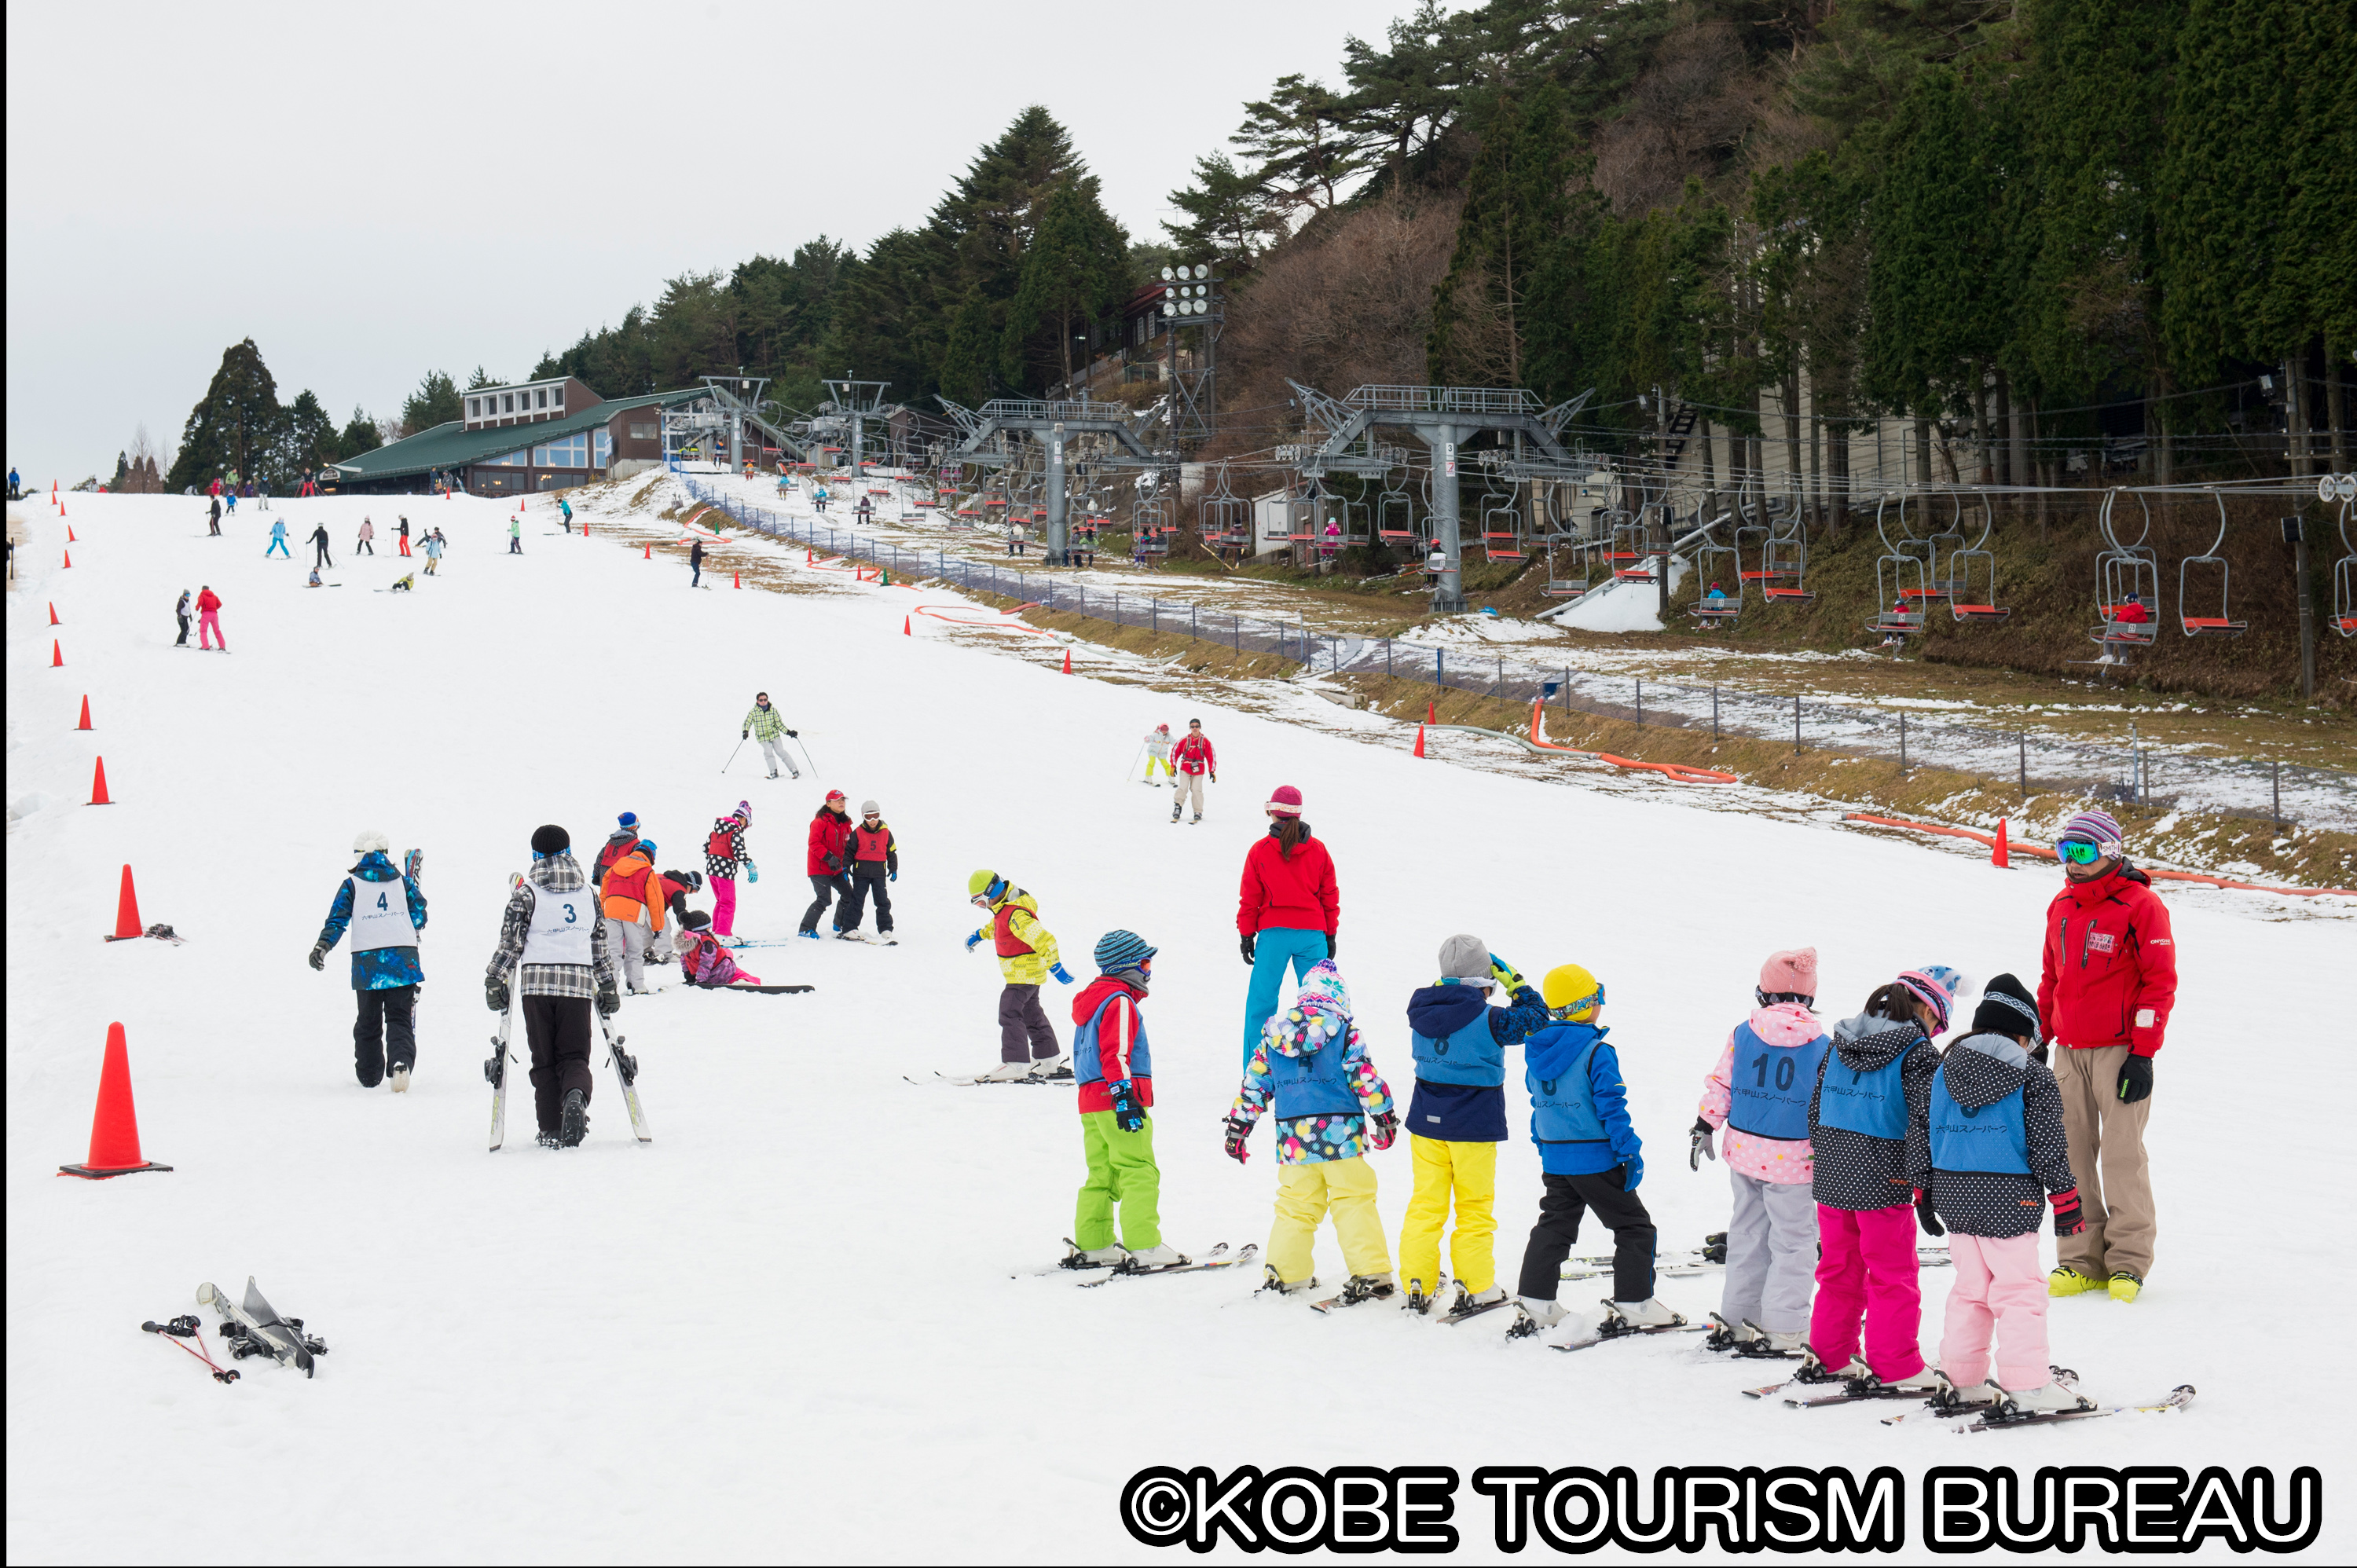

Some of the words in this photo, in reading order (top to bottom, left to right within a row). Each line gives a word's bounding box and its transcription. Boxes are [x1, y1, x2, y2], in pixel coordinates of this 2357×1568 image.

[870, 841, 876, 851] 5
[377, 892, 388, 911] 4
[563, 903, 577, 924] 3
[1752, 1053, 1795, 1091] 10
[1277, 1076, 1337, 1088] 六甲山スノーパーク
[1733, 1086, 1806, 1107] 六甲山スノーパーク
[1823, 1084, 1885, 1102] 六甲山スノーパーク
